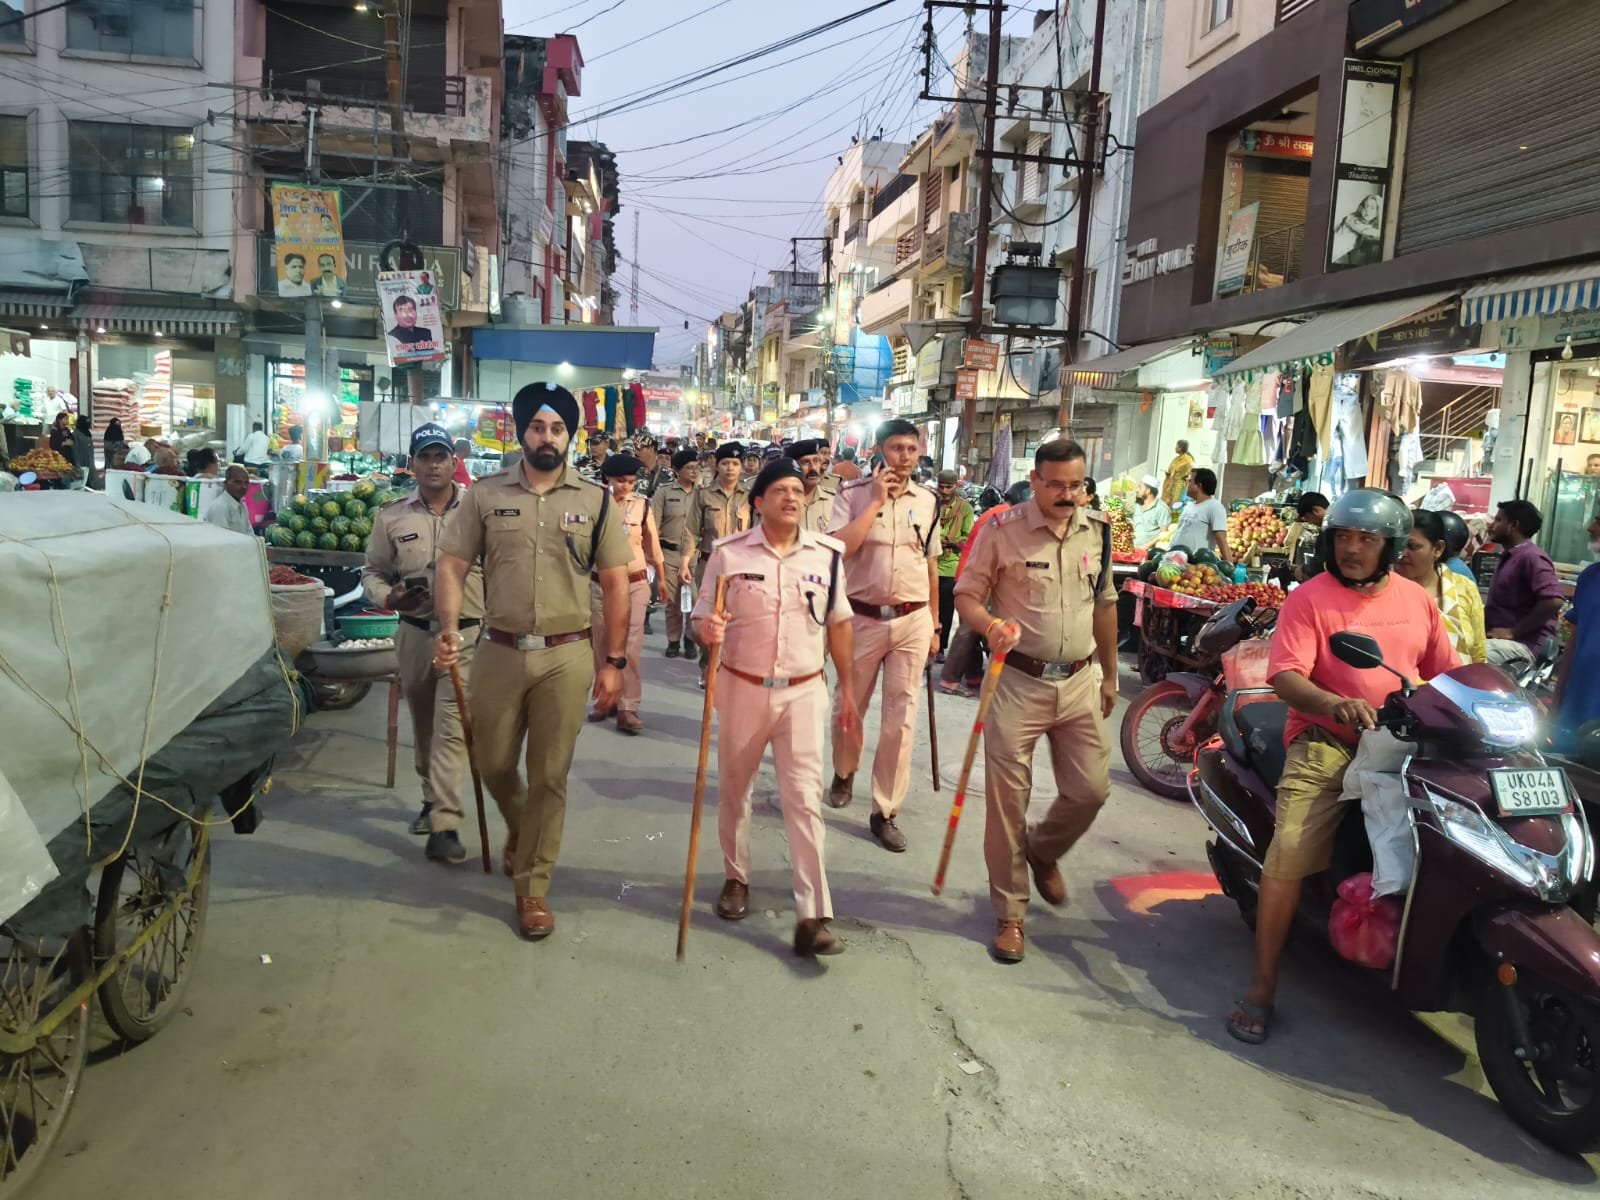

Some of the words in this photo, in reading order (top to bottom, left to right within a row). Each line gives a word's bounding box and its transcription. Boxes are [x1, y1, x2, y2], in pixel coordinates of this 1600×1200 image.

[416, 428, 446, 440] POLICE
[1507, 772, 1555, 789] UK04A
[1512, 790, 1560, 807] S8103
